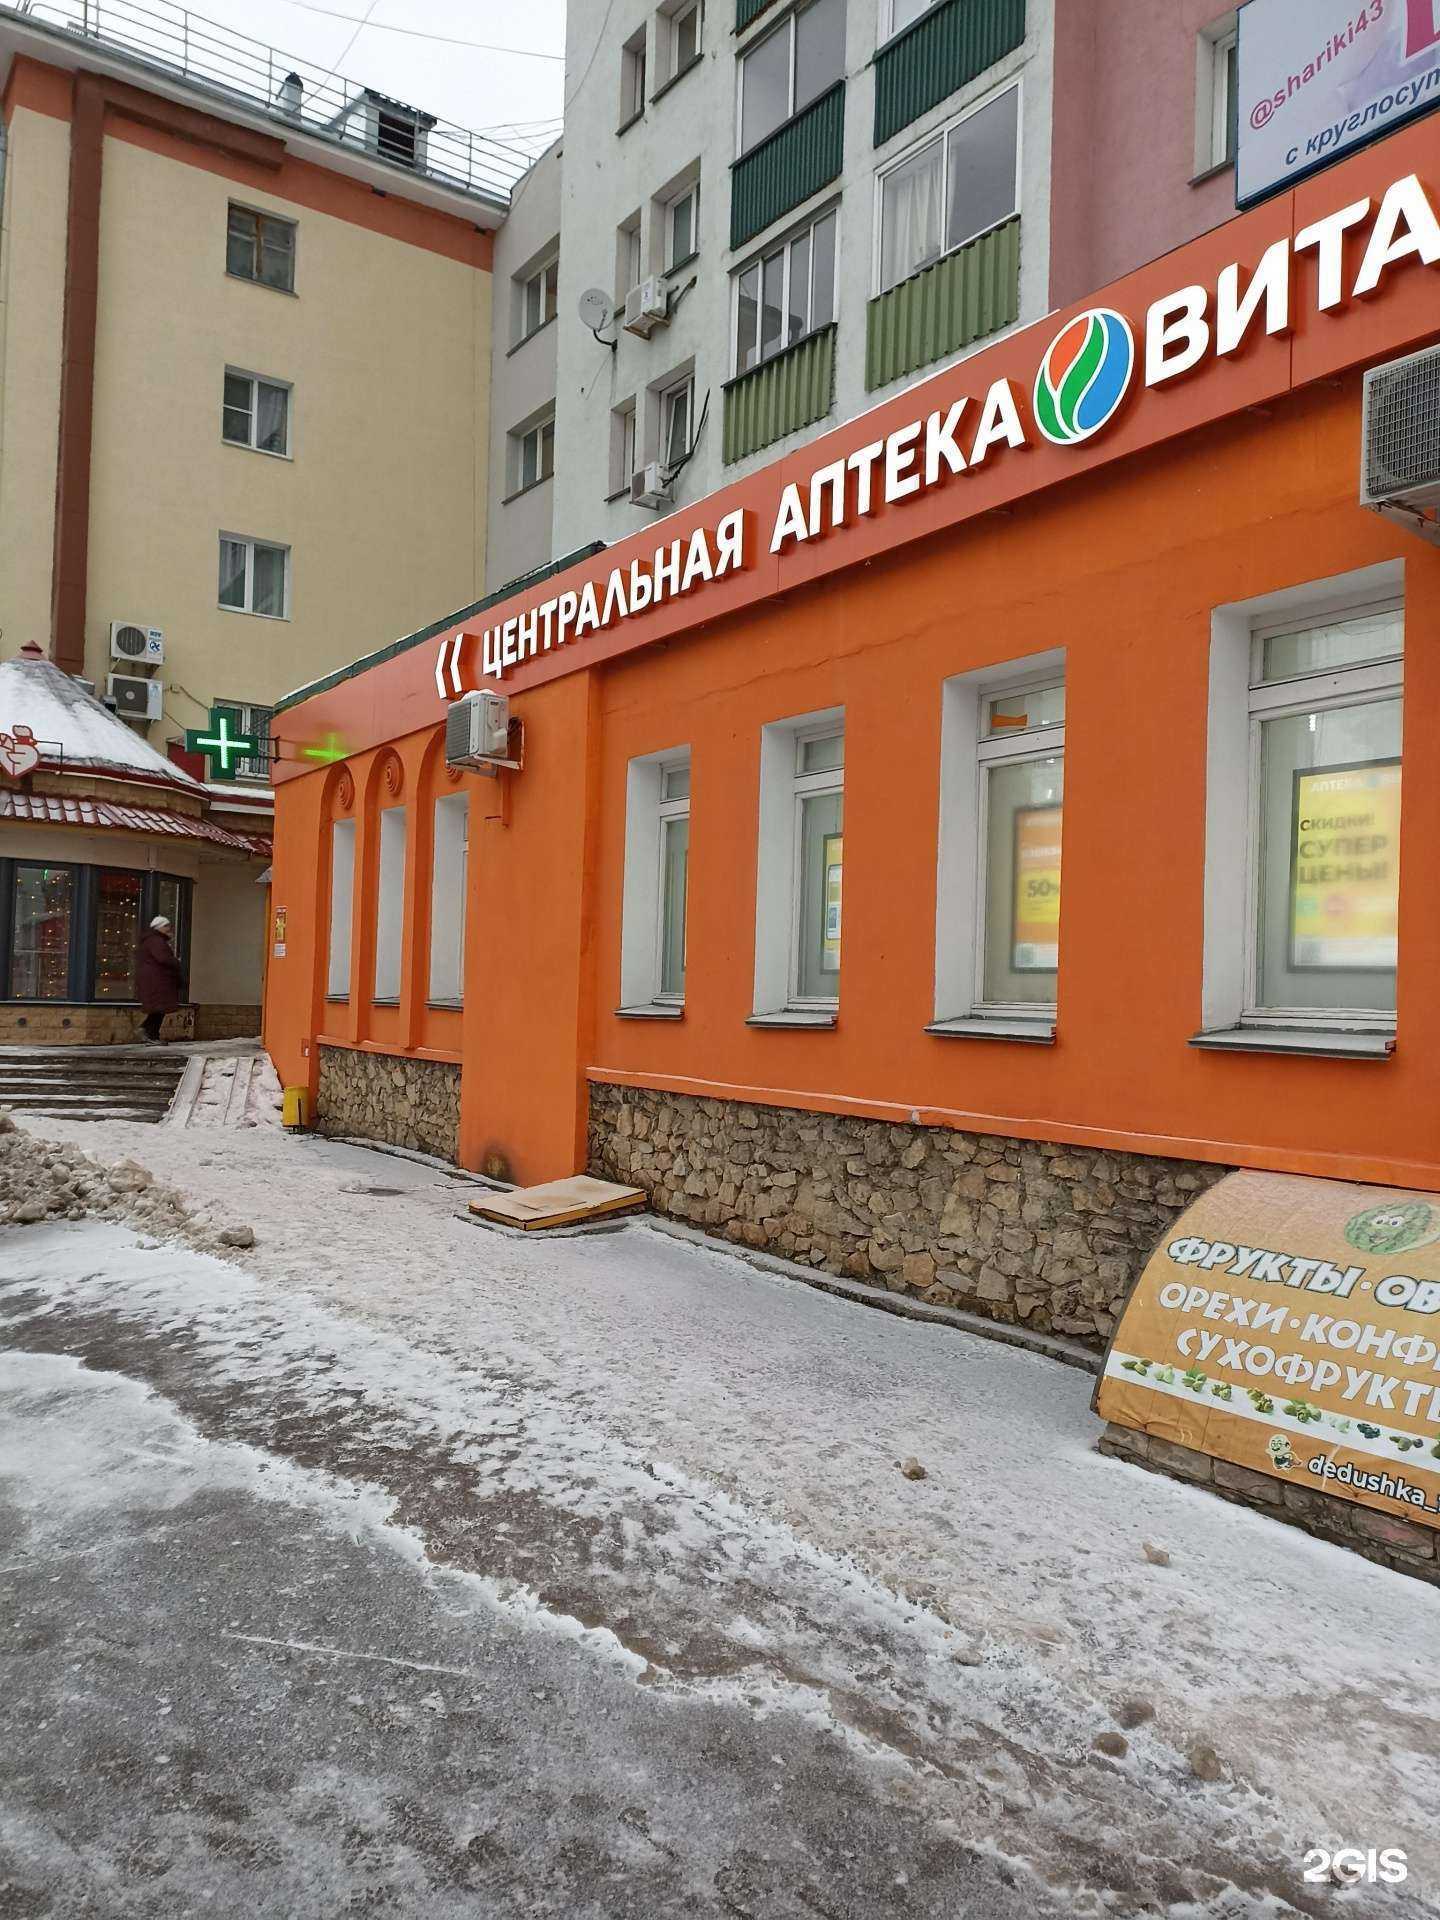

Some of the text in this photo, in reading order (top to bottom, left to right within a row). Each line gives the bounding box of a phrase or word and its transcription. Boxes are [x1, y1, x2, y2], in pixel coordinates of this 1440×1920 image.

[1250, 0, 1384, 130] @shariki43
[482, 173, 1440, 680] ЦЕНТРАЛЬНАЯ АПТЕКА ВИТА
[1300, 834, 1389, 860] СУПЕР
[1167, 1235, 1367, 1299] ФРУКТЫ
[1158, 1281, 1290, 1335] ОРЕХИ
[1307, 1454, 1440, 1515] dedushka_
